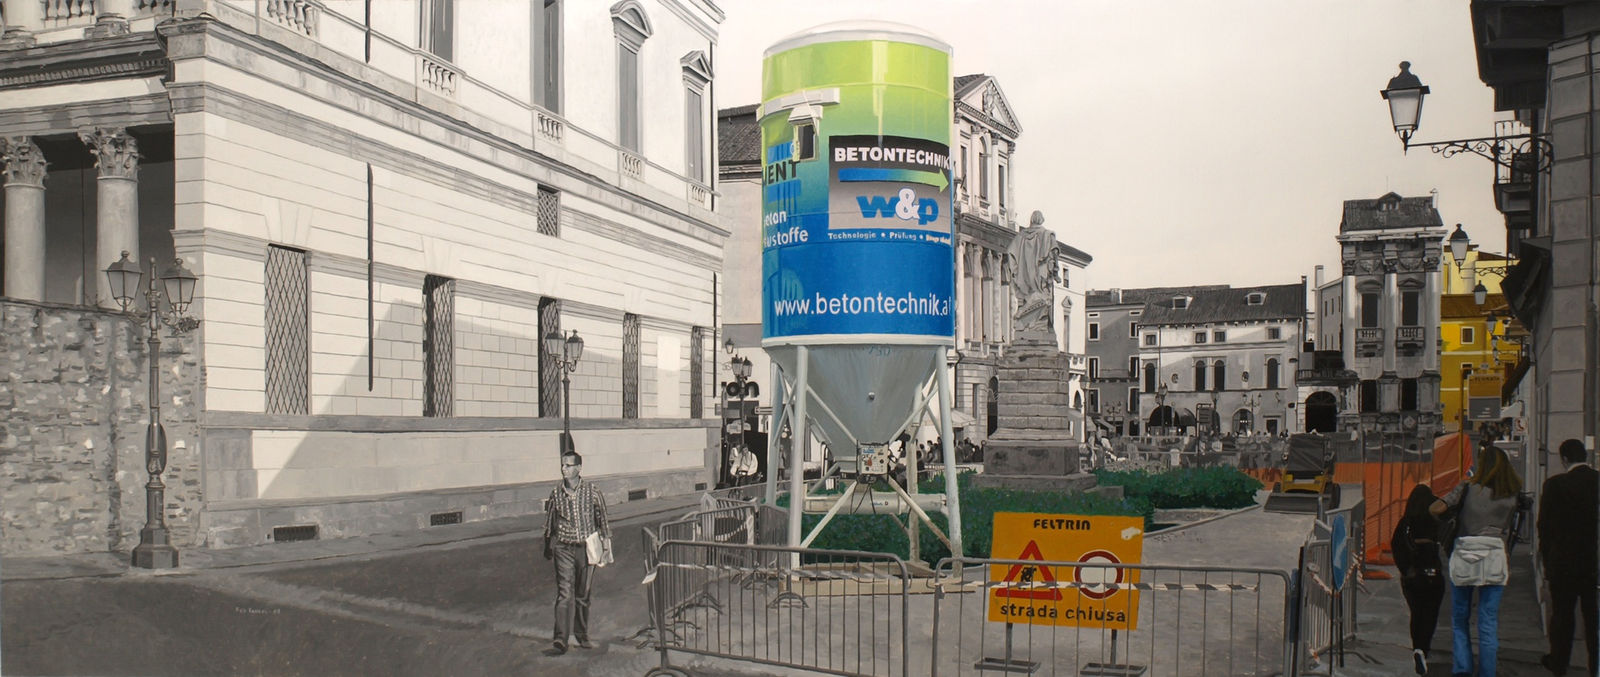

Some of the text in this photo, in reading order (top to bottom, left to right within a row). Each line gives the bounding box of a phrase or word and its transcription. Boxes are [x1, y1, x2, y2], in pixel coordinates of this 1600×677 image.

[835, 147, 951, 170] BETONTECHNIK
[856, 187, 939, 225] w&p
[828, 231, 876, 240] Technologie
[889, 231, 917, 241] Prüfung
[1034, 519, 1091, 530] FELTRIN
[1000, 603, 1126, 622] strada chiusa
